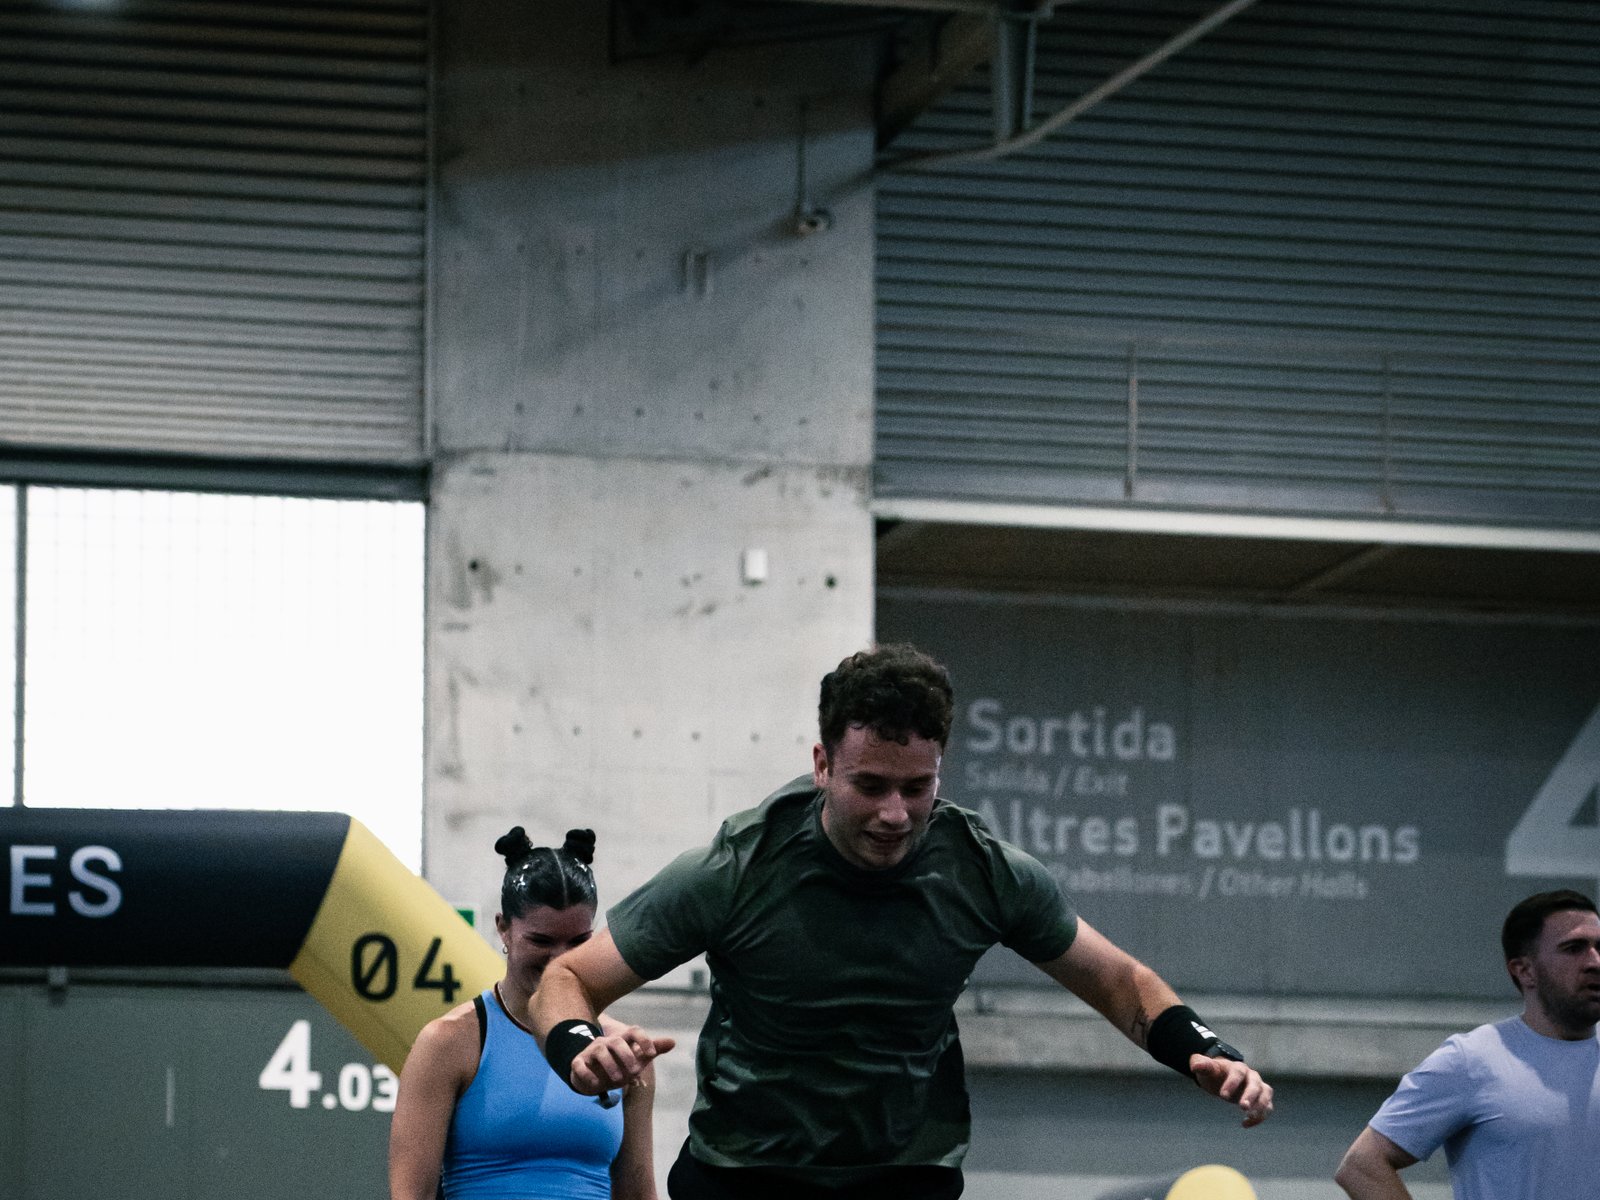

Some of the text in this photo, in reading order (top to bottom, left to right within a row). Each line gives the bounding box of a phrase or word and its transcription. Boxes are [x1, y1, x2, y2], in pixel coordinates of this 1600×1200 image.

[967, 699, 1176, 761] Sortida
[1155, 803, 1420, 863] Pavellons
[352, 931, 462, 1004] 04
